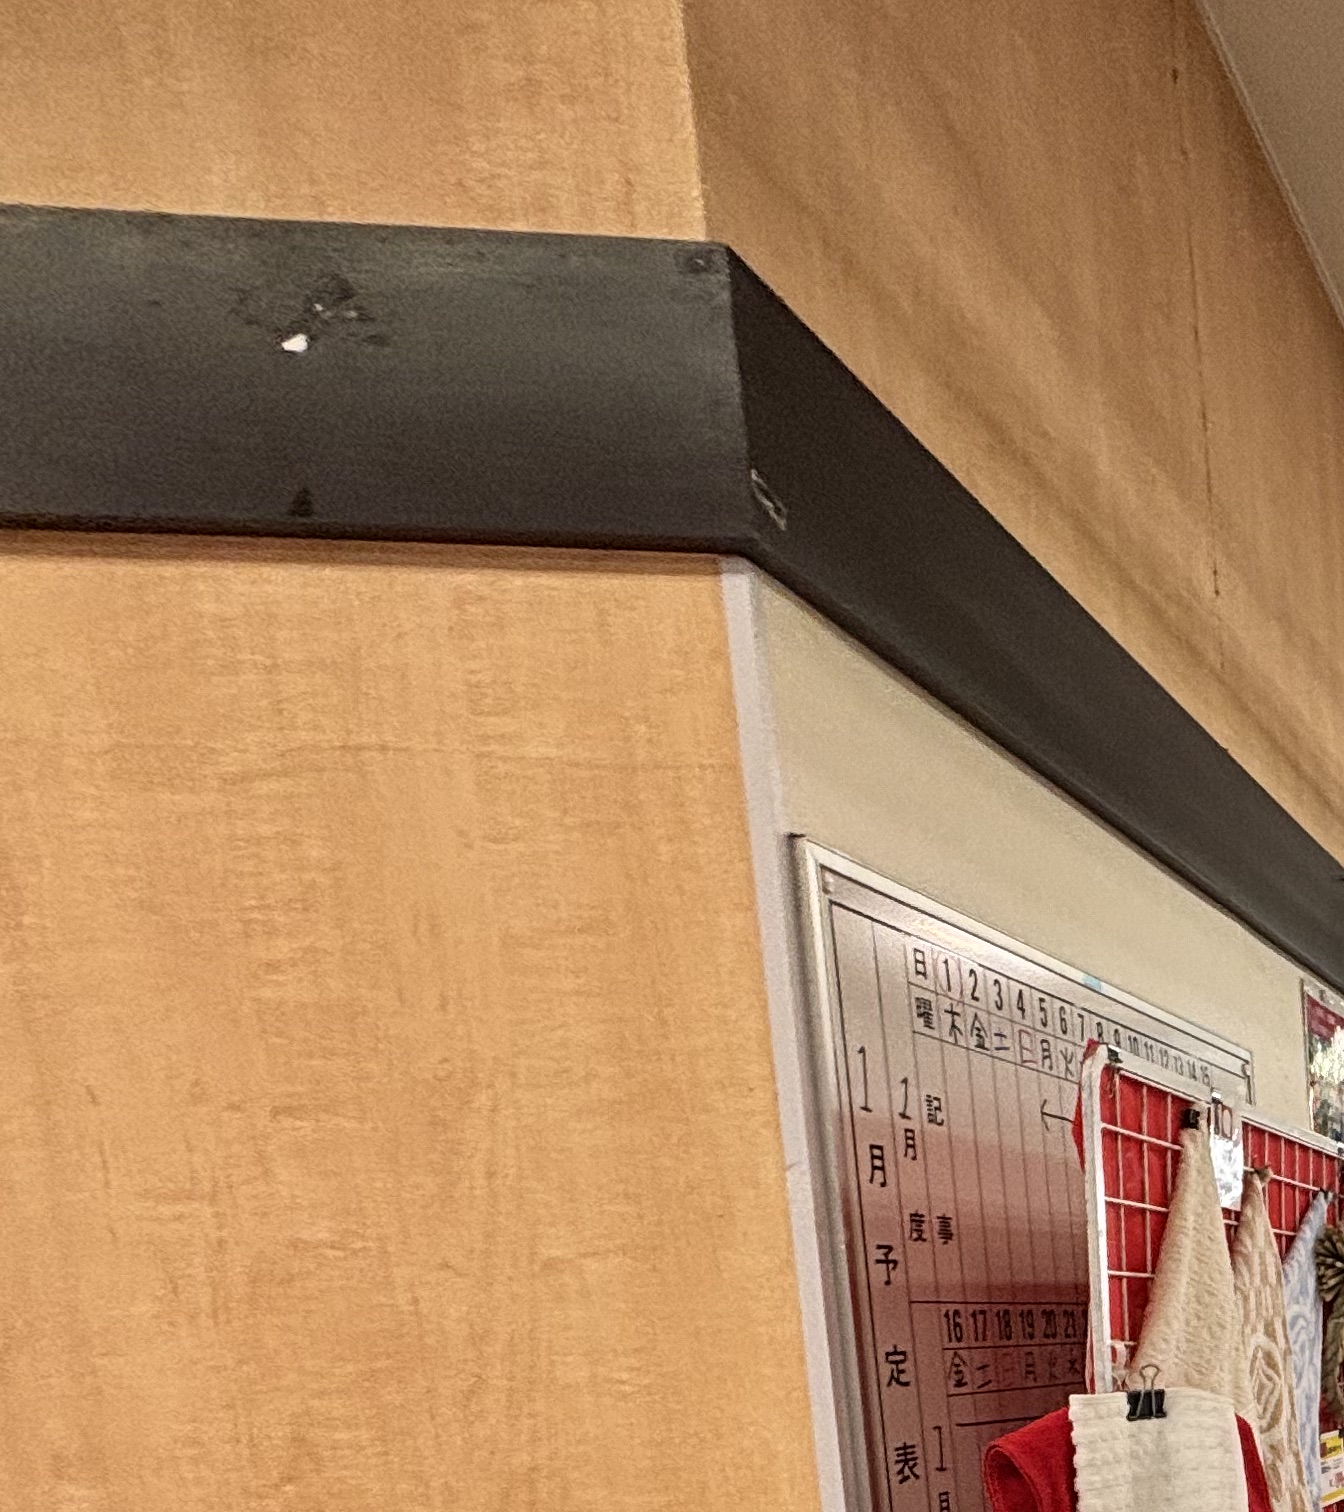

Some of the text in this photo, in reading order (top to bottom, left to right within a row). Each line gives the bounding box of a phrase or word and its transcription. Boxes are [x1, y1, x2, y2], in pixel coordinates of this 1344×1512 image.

[969, 968, 980, 1002] 2
[994, 978, 1003, 1011] 3
[1016, 989, 1026, 1020] 4
[1038, 997, 1048, 1028] 5
[1059, 1005, 1068, 1035] 6
[1077, 1012, 1085, 1042] 7
[944, 1309, 963, 1343] 16
[971, 1310, 987, 1342] 17
[996, 1309, 1013, 1340] 18
[1019, 1309, 1035, 1340] 19
